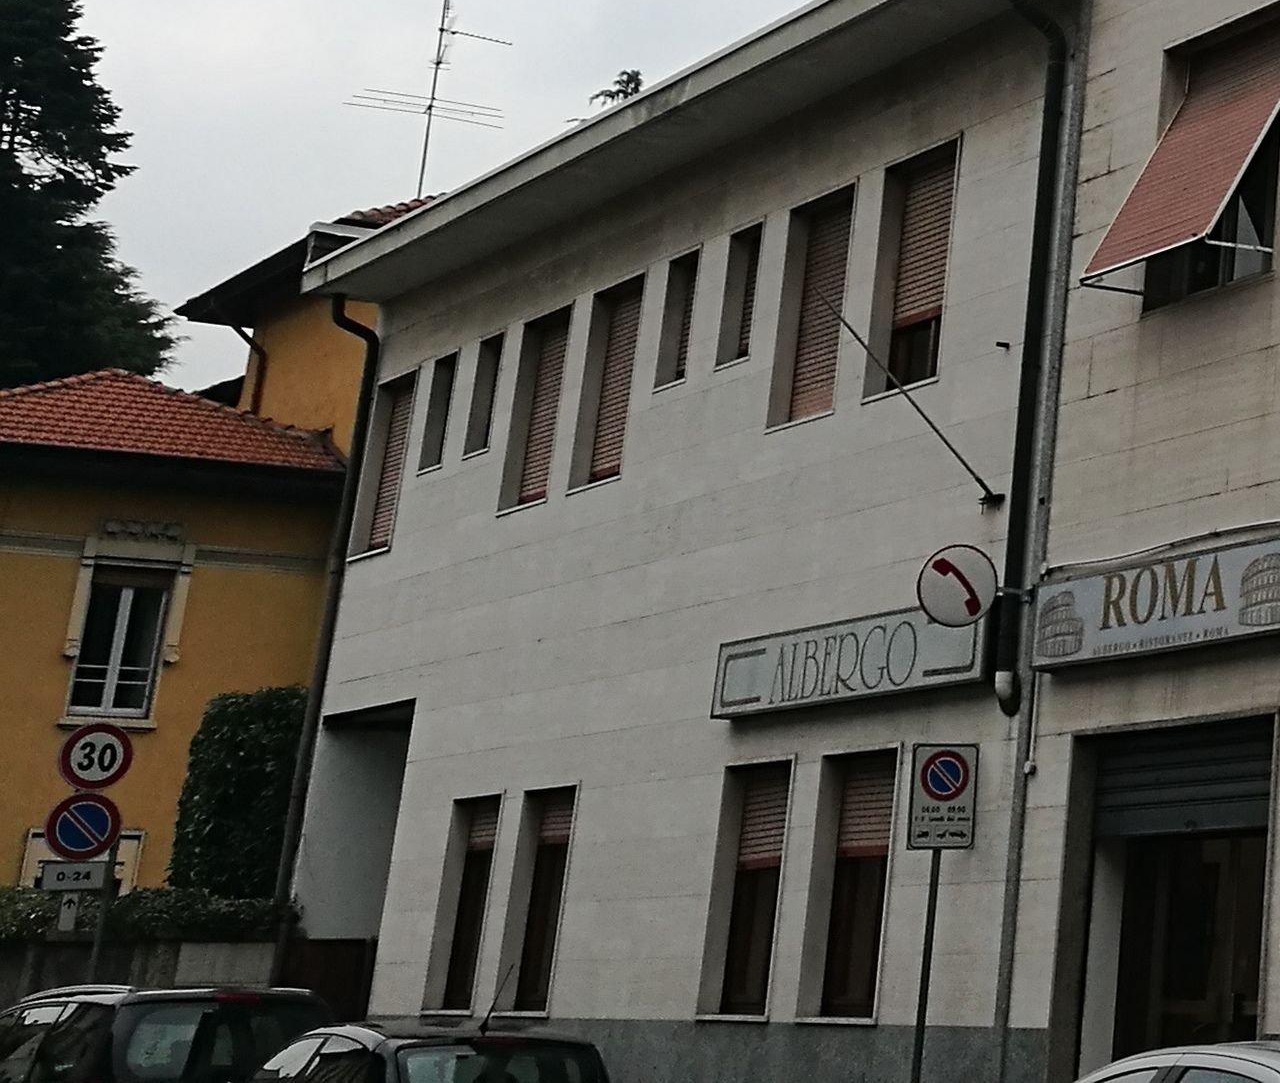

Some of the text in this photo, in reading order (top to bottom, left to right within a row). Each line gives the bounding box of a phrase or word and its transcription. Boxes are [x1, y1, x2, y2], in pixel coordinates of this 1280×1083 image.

[1100, 553, 1226, 630] ROMA
[1202, 625, 1229, 640] ROMA
[768, 620, 917, 705] ALBERGO
[77, 741, 118, 773] 30
[56, 870, 92, 882] 0-24
